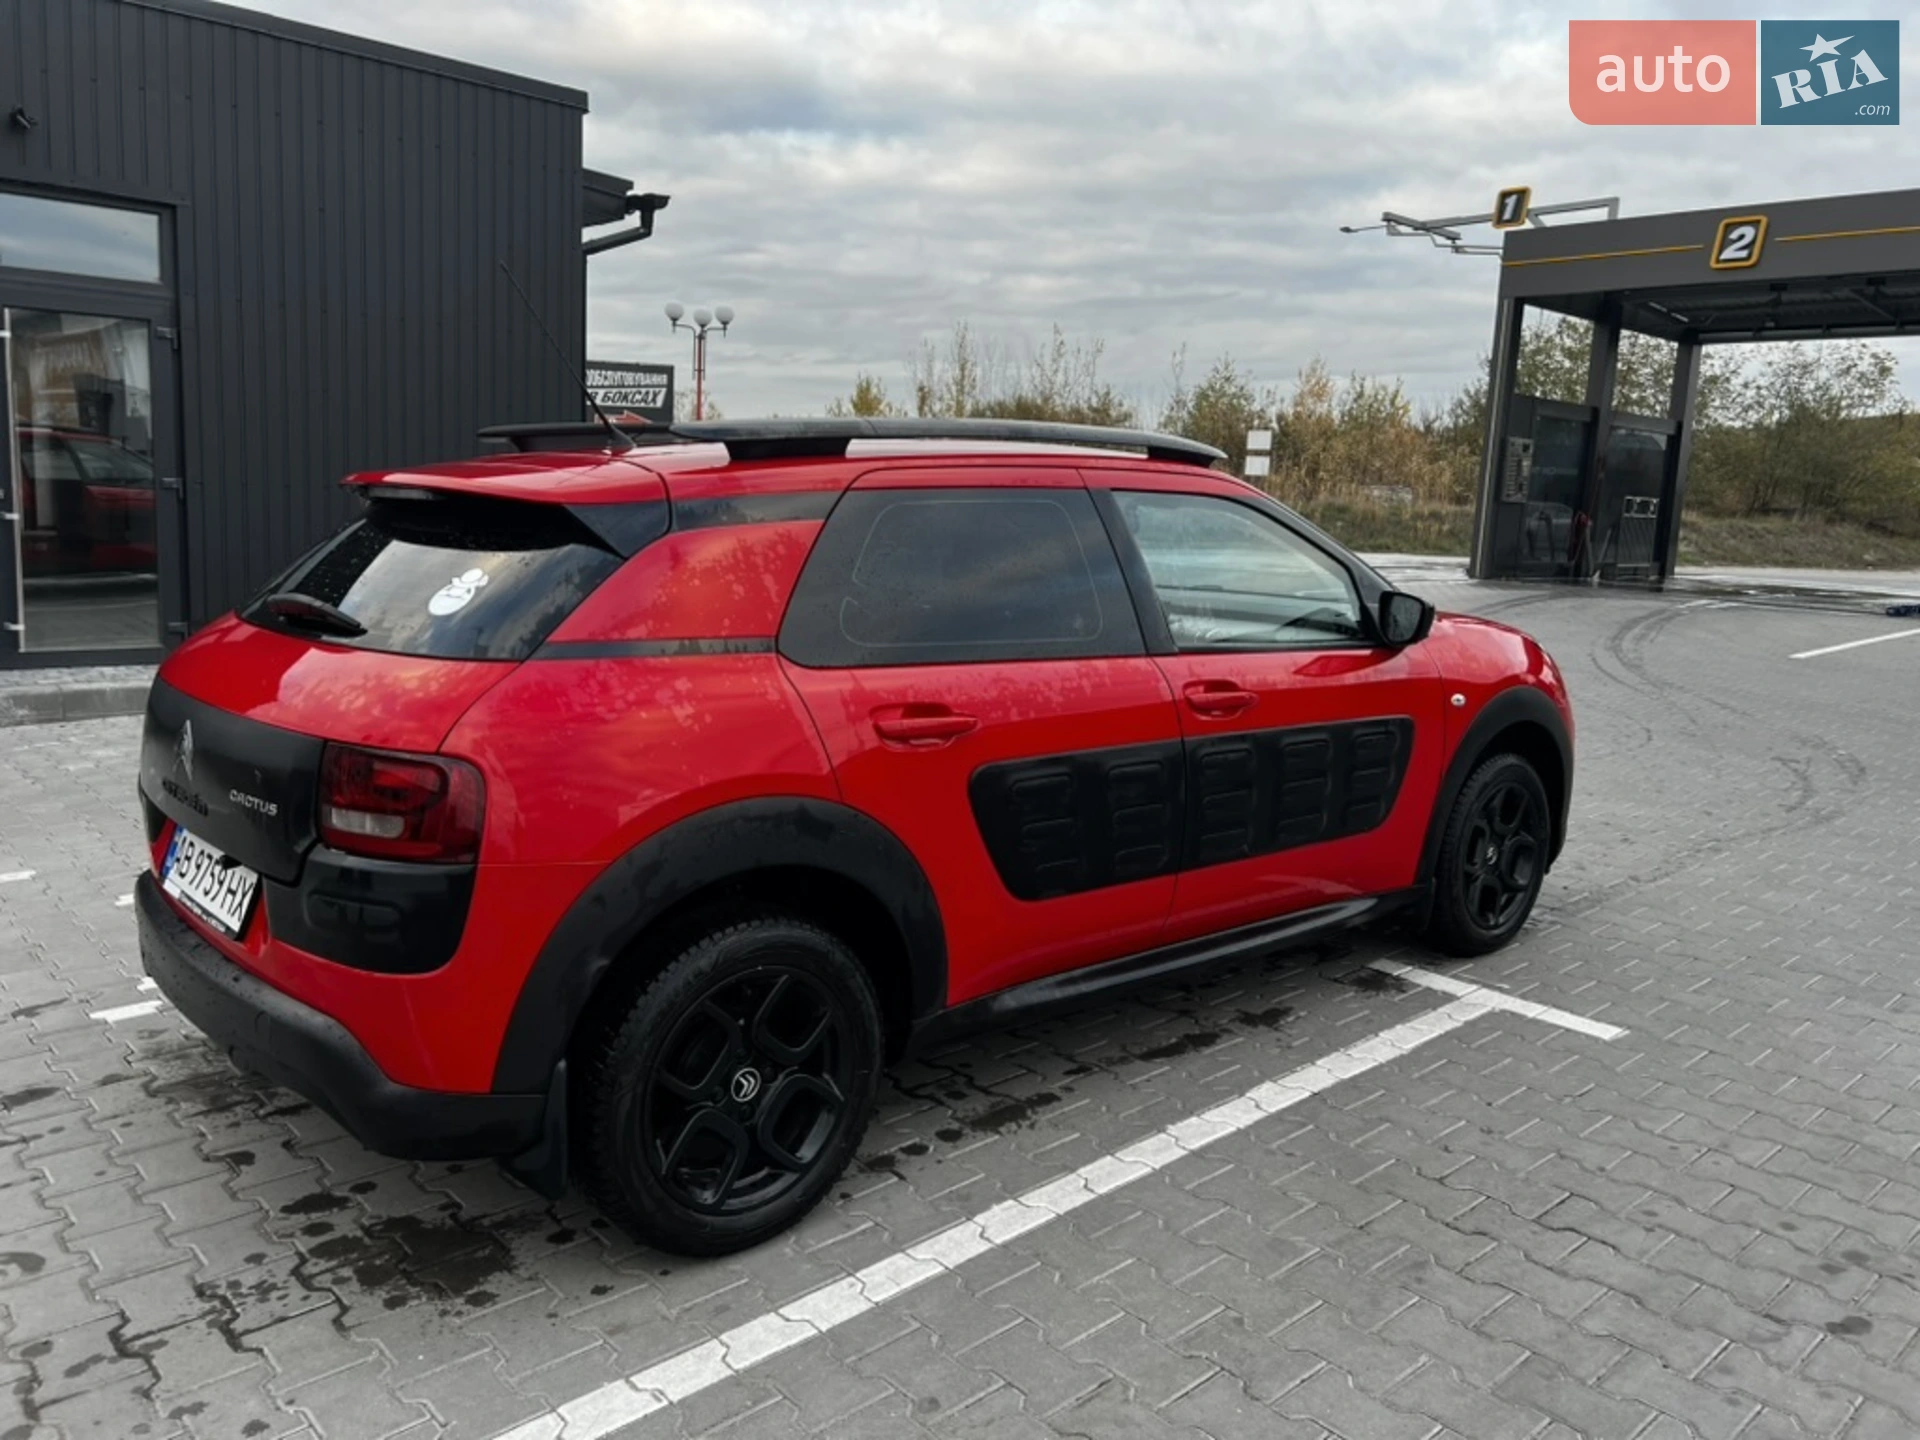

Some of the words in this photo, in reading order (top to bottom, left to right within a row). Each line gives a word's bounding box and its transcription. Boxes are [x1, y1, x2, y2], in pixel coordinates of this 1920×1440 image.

[1502, 194, 1519, 221] 1
[1719, 226, 1756, 261] 2
[602, 389, 662, 406] БОКСАХ
[229, 789, 278, 817] CACTUS
